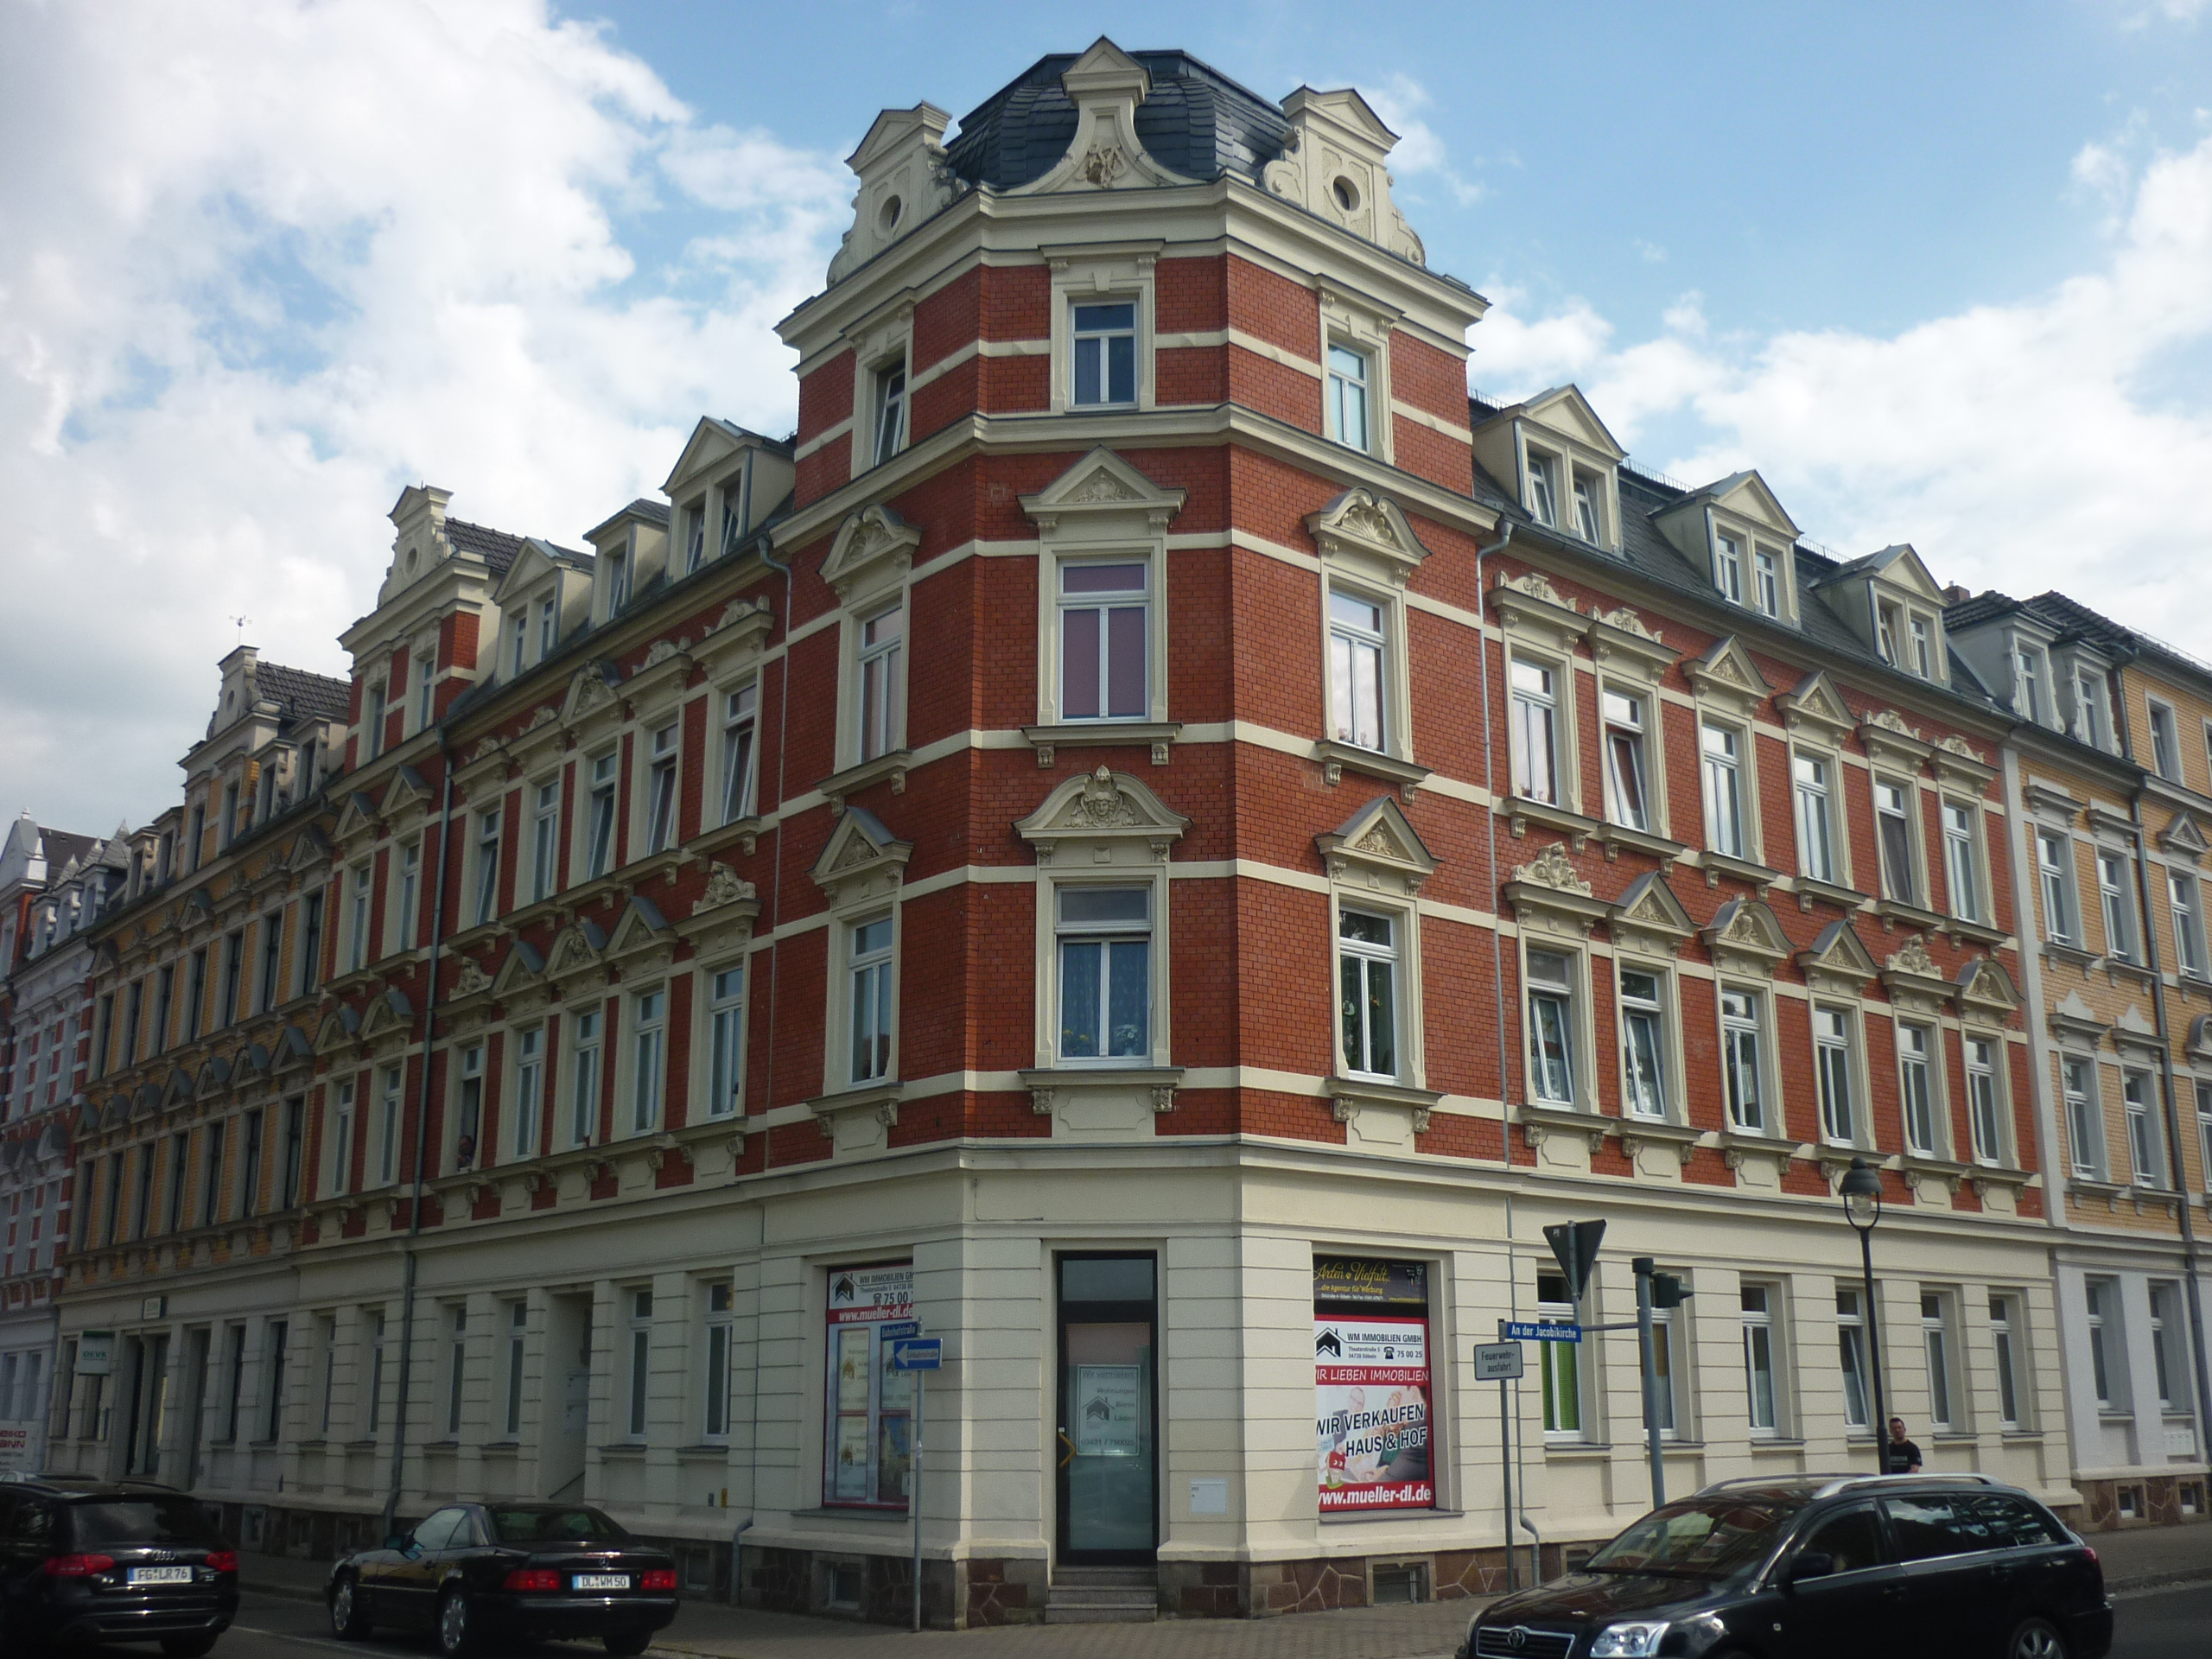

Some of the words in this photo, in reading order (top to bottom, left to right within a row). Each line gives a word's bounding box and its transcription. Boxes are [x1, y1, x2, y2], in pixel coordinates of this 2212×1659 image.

[871, 1274, 904, 1282] IMMOBILIEN
[1331, 1284, 1351, 1294] Agentur
[884, 1293, 894, 1305] 75
[898, 1292, 908, 1304] 00
[1511, 1325, 1520, 1335] An
[1522, 1325, 1534, 1336] der
[1535, 1326, 1577, 1338] Jacobikirche
[1362, 1333, 1401, 1342] IMMOBILIEN
[1482, 1350, 1515, 1361] Feuerwehr-
[1487, 1363, 1511, 1372] ausfahrt
[1331, 1369, 1366, 1381] LIEBEN
[1370, 1370, 1429, 1382] IMMOBILIEN
[1344, 1403, 1424, 1431] VERKAUFEN
[1346, 1436, 1382, 1457] HAUS
[1387, 1433, 1396, 1450] &
[1401, 1428, 1427, 1447] HOF
[138, 1569, 152, 1580] FG
[175, 1568, 187, 1579] 76
[582, 1577, 594, 1587] DL
[601, 1577, 613, 1586] WM
[614, 1577, 626, 1586] 50
